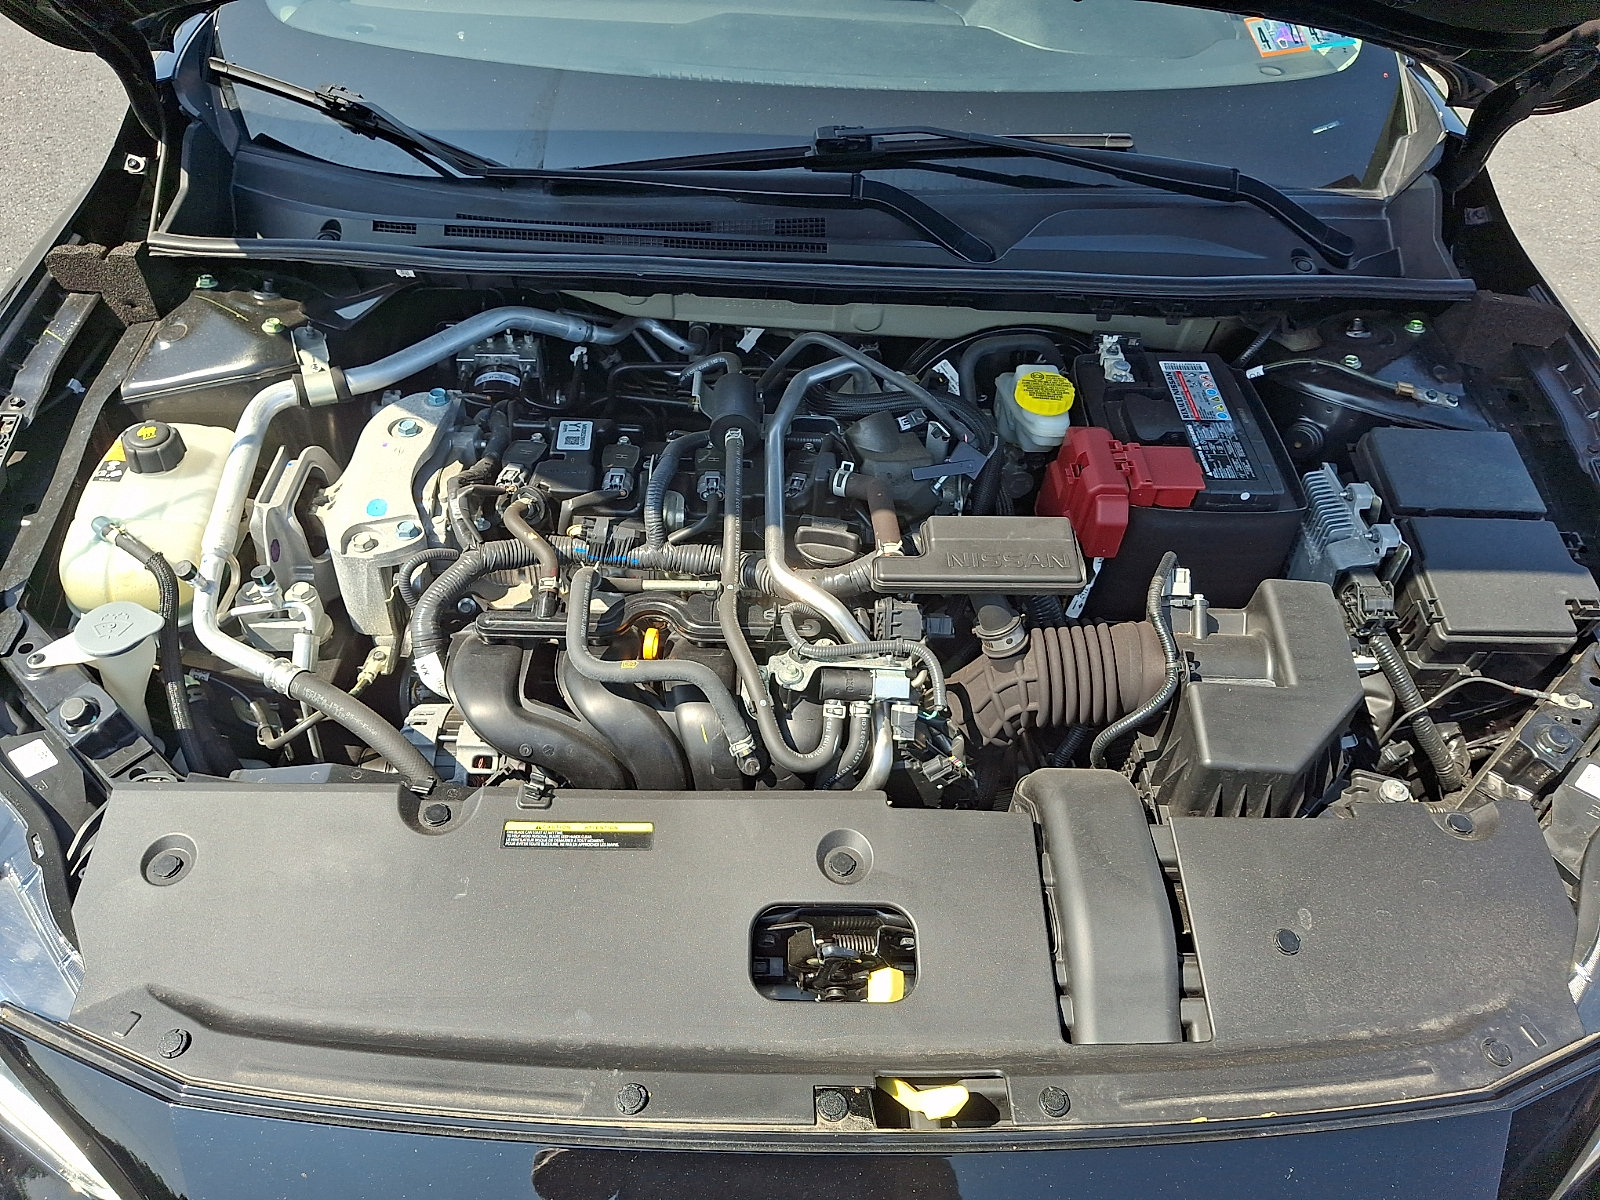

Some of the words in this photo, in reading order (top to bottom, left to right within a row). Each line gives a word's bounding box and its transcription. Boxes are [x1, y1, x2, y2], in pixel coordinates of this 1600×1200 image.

[1257, 26, 1271, 50] 4
[1165, 371, 1181, 395] NISSAN
[568, 422, 582, 432] Y1
[946, 552, 1071, 569] NISSAN
